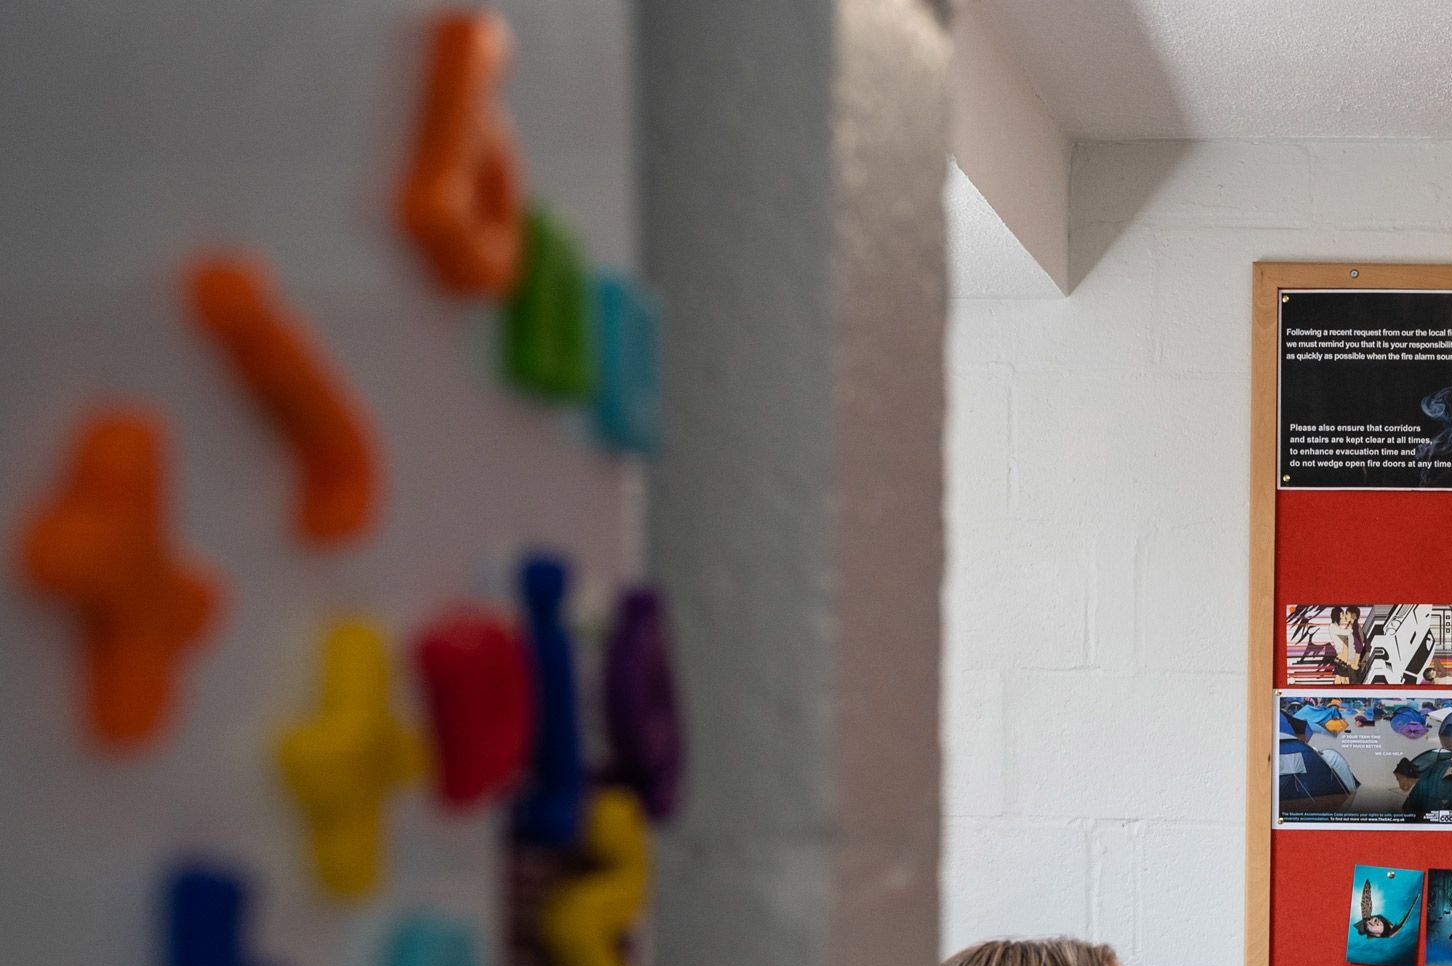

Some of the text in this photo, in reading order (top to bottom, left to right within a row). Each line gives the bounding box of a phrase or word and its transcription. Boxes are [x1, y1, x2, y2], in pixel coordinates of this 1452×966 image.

[1286, 328, 1323, 338] Following
[1329, 328, 1353, 336] recent
[1353, 329, 1382, 338] request
[1382, 328, 1401, 337] from
[1415, 329, 1428, 337] the
[1428, 329, 1447, 337] local
[1298, 340, 1318, 348] must
[1318, 340, 1345, 348] remind
[1345, 341, 1360, 350] you
[1360, 340, 1376, 348] that
[1376, 340, 1382, 348] it
[1382, 340, 1390, 348] is
[1390, 342, 1409, 350] your
[1296, 352, 1324, 362] quickly
[1334, 352, 1366, 362] possible
[1366, 352, 1387, 360] when
[1387, 352, 1401, 360] the
[1400, 352, 1414, 360] fire
[1414, 352, 1436, 361] alarm
[1289, 423, 1317, 432] Please
[1318, 424, 1336, 432] also
[1366, 424, 1383, 432] that
[1383, 424, 1422, 432] corridors
[1289, 435, 1306, 443] and
[1306, 435, 1330, 444] stairs
[1345, 436, 1364, 445] kept
[1364, 436, 1386, 444] clear
[1386, 436, 1395, 444] at
[1396, 436, 1407, 444] all
[1407, 435, 1433, 445] times,
[1299, 447, 1334, 455] enhance
[1335, 447, 1380, 456] evacuation
[1381, 448, 1399, 456] time
[1400, 447, 1416, 455] and
[1289, 459, 1301, 467] do
[1317, 459, 1344, 469] wedge
[1344, 461, 1366, 469] open
[1367, 459, 1381, 467] fire
[1382, 460, 1406, 468] doors
[1407, 460, 1416, 468] at
[1417, 461, 1433, 470] any
